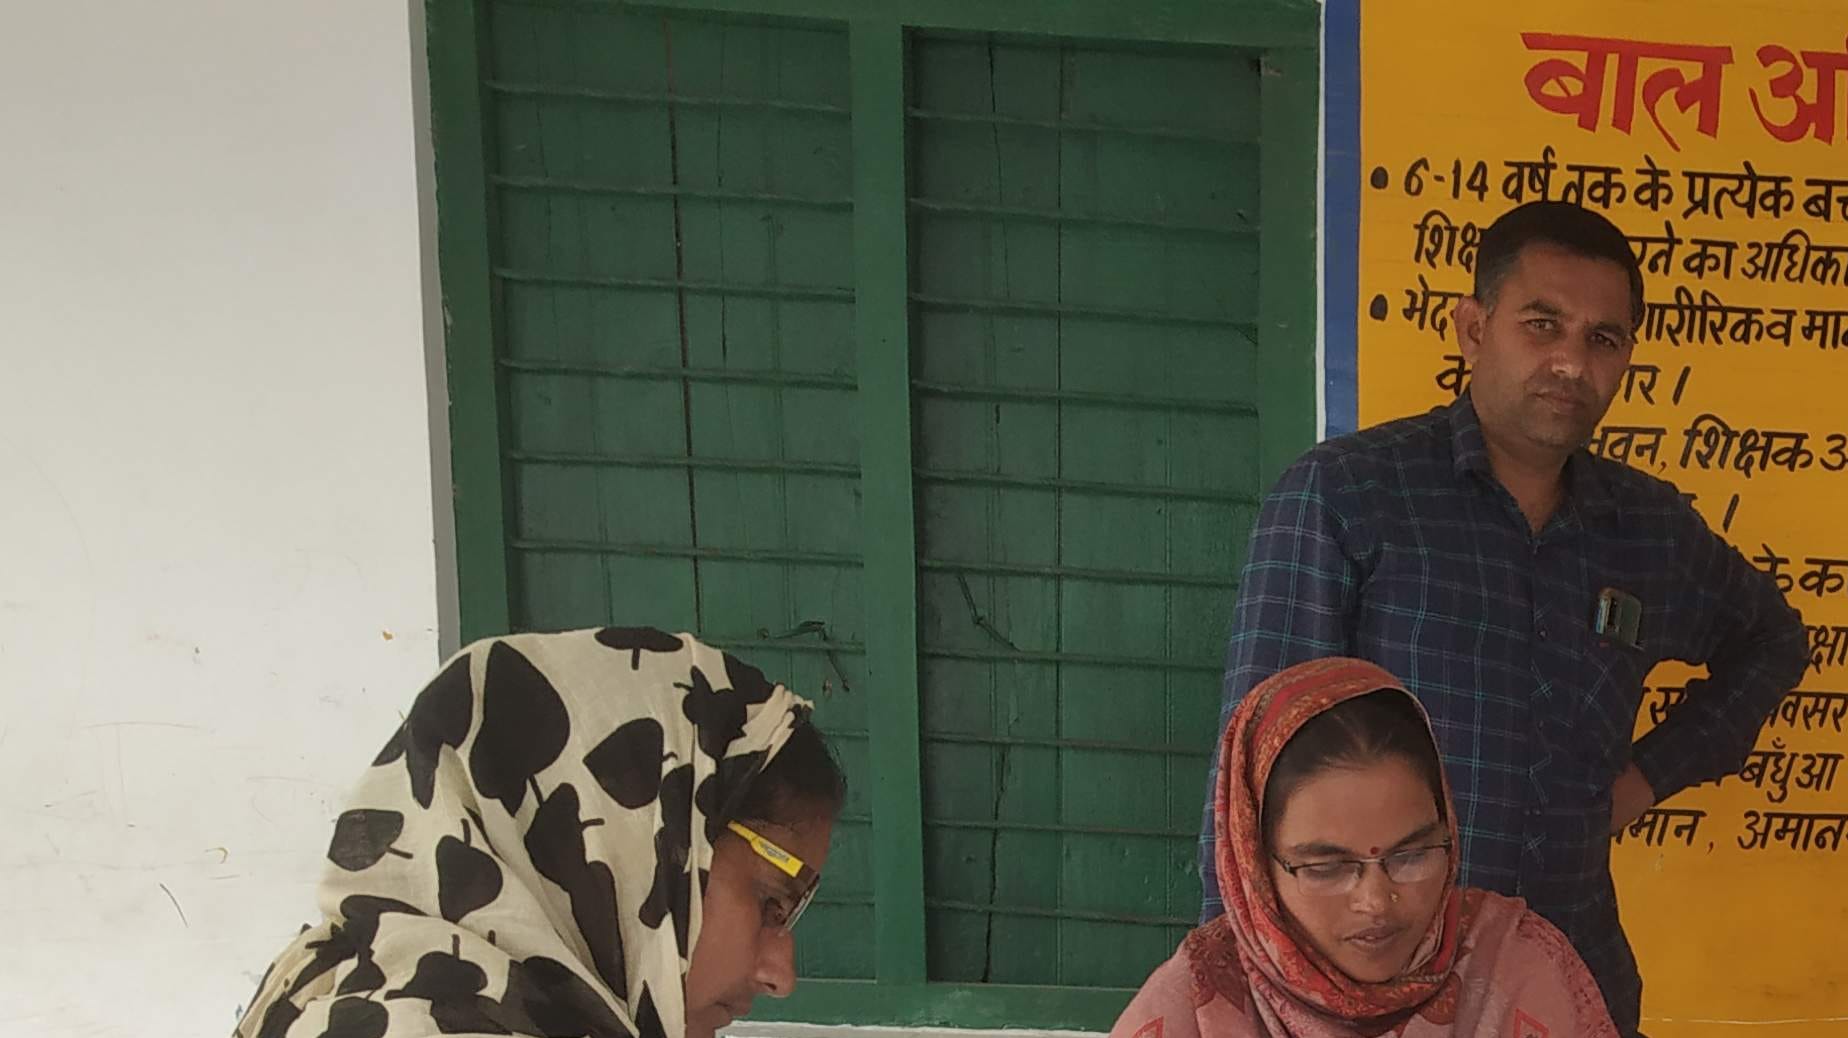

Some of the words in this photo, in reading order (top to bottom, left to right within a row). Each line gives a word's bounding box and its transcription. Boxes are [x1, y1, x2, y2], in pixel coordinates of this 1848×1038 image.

[1520, 32, 1733, 152] बाल
[1403, 157, 1489, 202] 6-14
[1502, 145, 1558, 203] वर्ष
[1562, 164, 1627, 210] तक
[1633, 154, 1674, 211] के
[1682, 161, 1793, 220] प्रत्येक
[1683, 238, 1739, 280] का
[1680, 413, 1815, 479] शिक्षक
